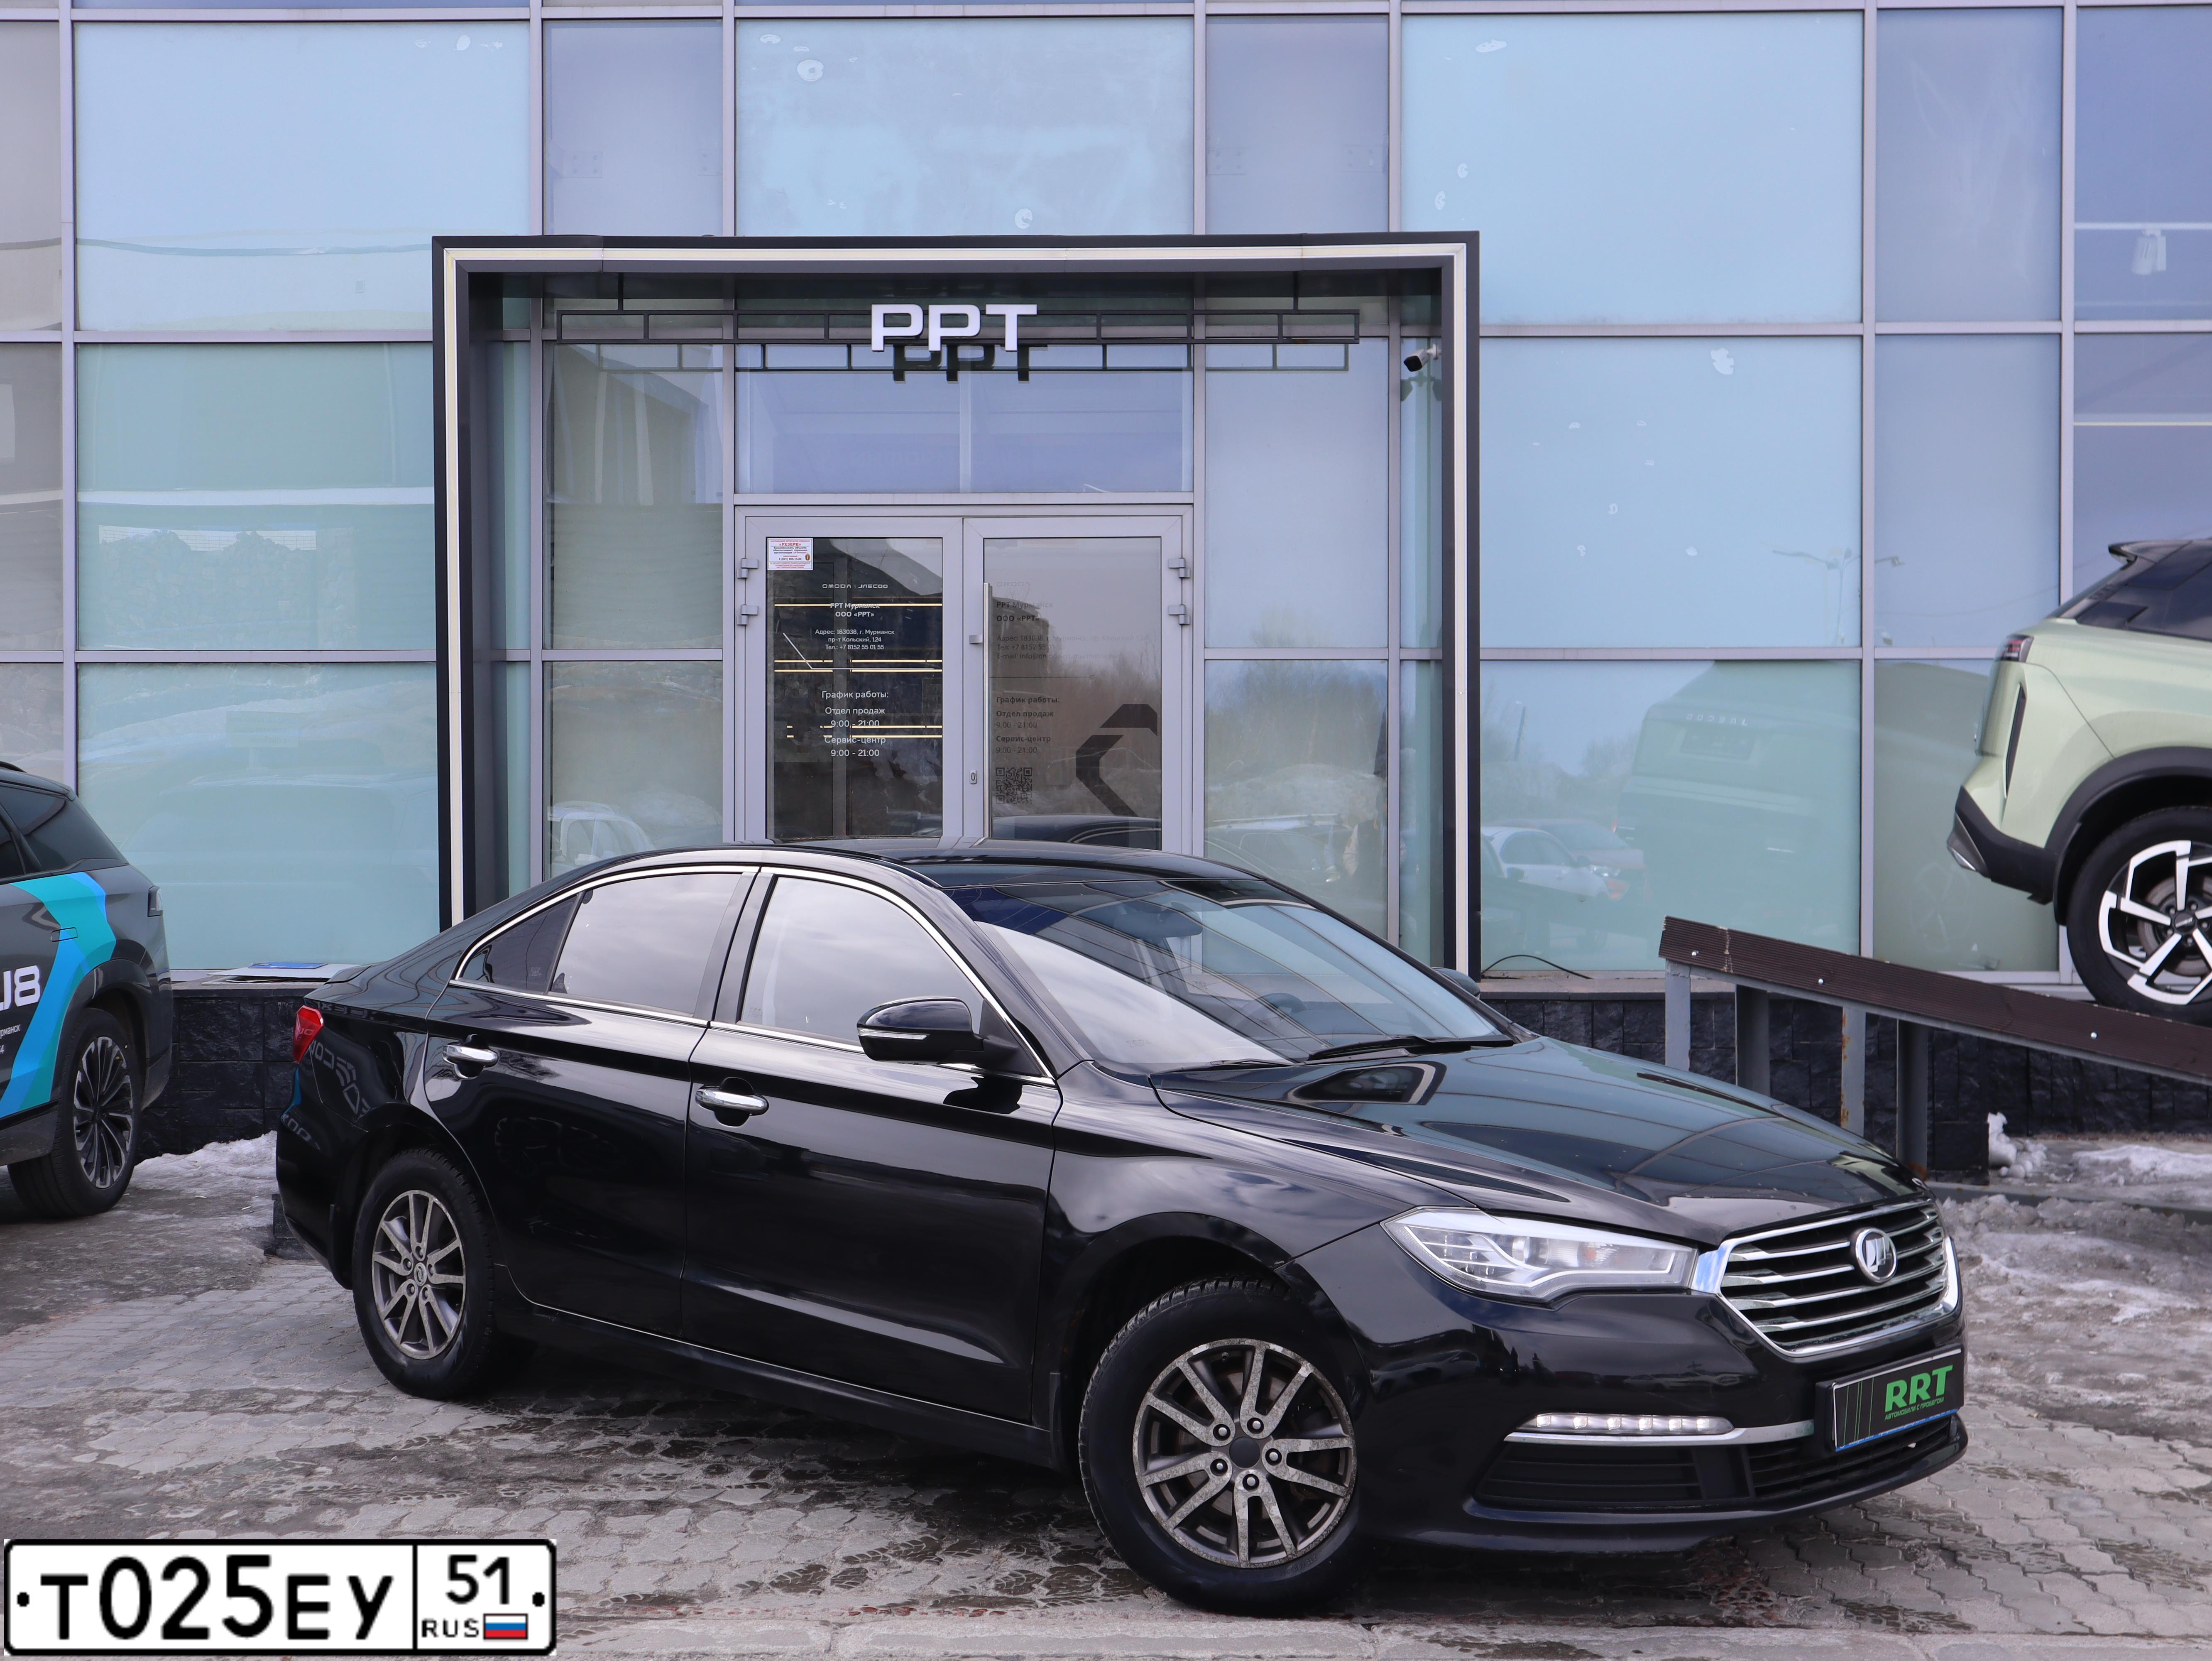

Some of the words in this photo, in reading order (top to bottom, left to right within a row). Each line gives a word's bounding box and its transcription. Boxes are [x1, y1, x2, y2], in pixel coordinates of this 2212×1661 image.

[871, 304, 1037, 351] РРТ
[821, 691, 854, 700] График
[855, 691, 889, 700] работы:
[996, 696, 1026, 705] График
[1028, 696, 1060, 705] работы:
[824, 737, 886, 745] Сервис-центр
[1884, 1365, 1953, 1413] RRT
[1884, 1405, 1916, 1421] АВТОМОБИЛИ
[1920, 1397, 1945, 1410] ПРОБЕГОМ
